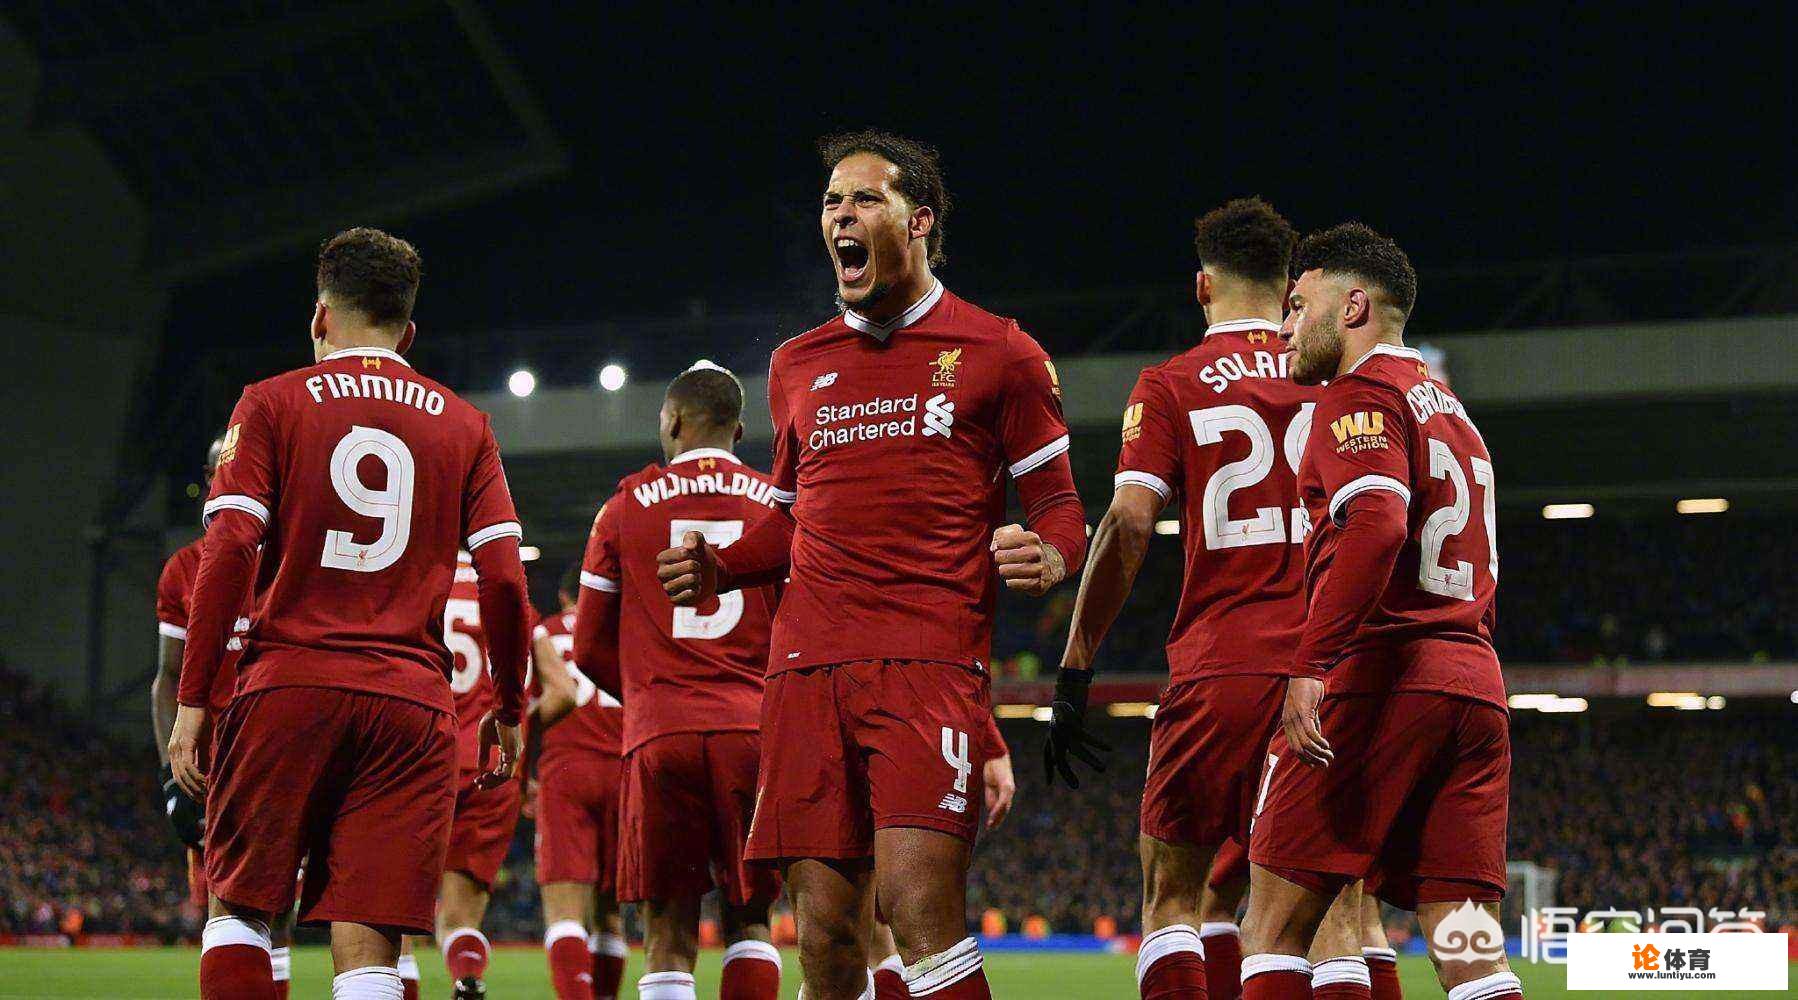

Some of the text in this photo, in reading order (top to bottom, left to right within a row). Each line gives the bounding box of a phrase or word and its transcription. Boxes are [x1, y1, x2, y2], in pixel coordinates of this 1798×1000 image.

[305, 373, 445, 416] FIRMINO
[815, 393, 919, 426] Standard
[808, 415, 916, 450] Chartered
[1330, 411, 1385, 444] WU
[1336, 436, 1387, 453] WESTERN
[1351, 441, 1389, 454] UNION
[320, 425, 415, 572] 9
[941, 727, 972, 793] 4
